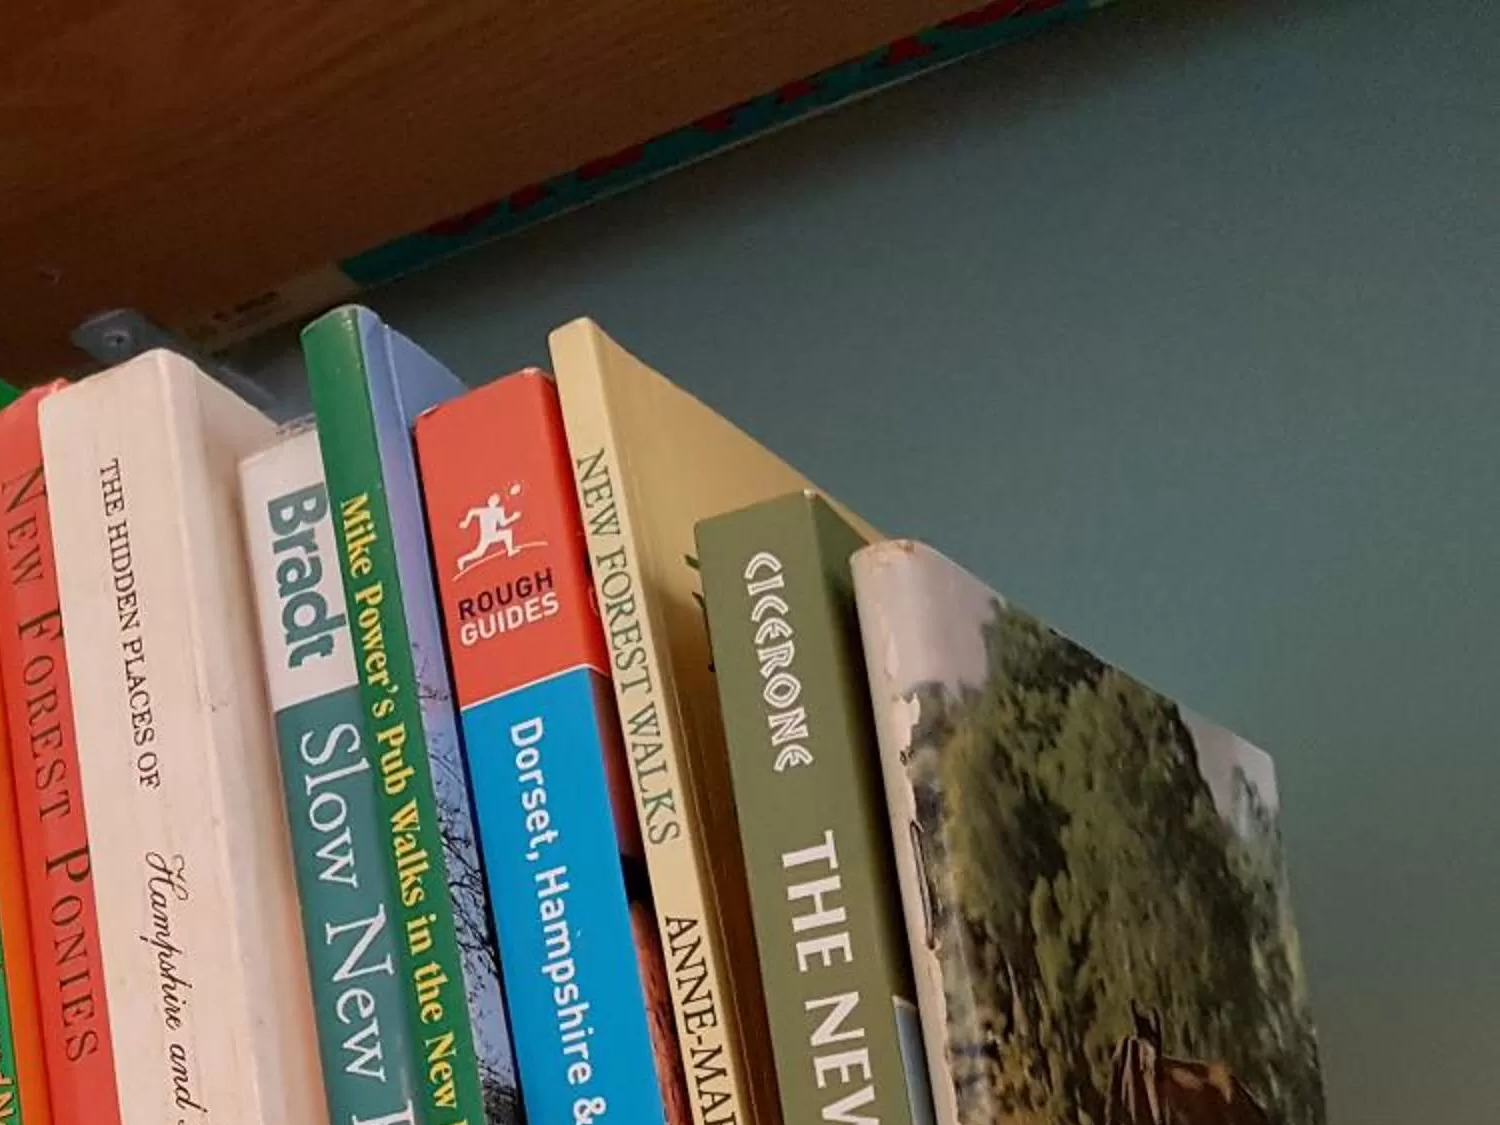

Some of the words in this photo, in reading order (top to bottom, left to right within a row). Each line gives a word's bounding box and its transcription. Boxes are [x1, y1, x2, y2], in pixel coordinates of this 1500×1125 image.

[2, 463, 48, 585] NEW
[100, 457, 125, 517] THE
[340, 491, 378, 580] Mike
[576, 447, 621, 539] NEW
[107, 519, 140, 633] HIDDEN
[267, 482, 347, 669] Bradt
[457, 566, 555, 622] ROUGH
[460, 591, 560, 647] GUIDES
[595, 543, 653, 696] FOREST
[122, 636, 155, 747] PLACES
[355, 581, 400, 719] Power's
[743, 551, 814, 774] CICERONE
[18, 604, 71, 821] FOREST
[137, 751, 161, 791] OF
[376, 721, 416, 796] Pub
[300, 722, 370, 889] Slow
[510, 716, 561, 862] Dorset,
[627, 702, 681, 846] WALKS
[388, 799, 430, 909] Walks
[781, 828, 854, 973] THE
[45, 843, 98, 1062] PONIES
[139, 850, 192, 1031] Hampshire
[169, 1043, 208, 1114] and
[325, 903, 395, 1084] New
[405, 911, 438, 956] in
[413, 959, 449, 1025] the
[534, 864, 595, 1086] Hampshire
[425, 1031, 458, 1110] New
